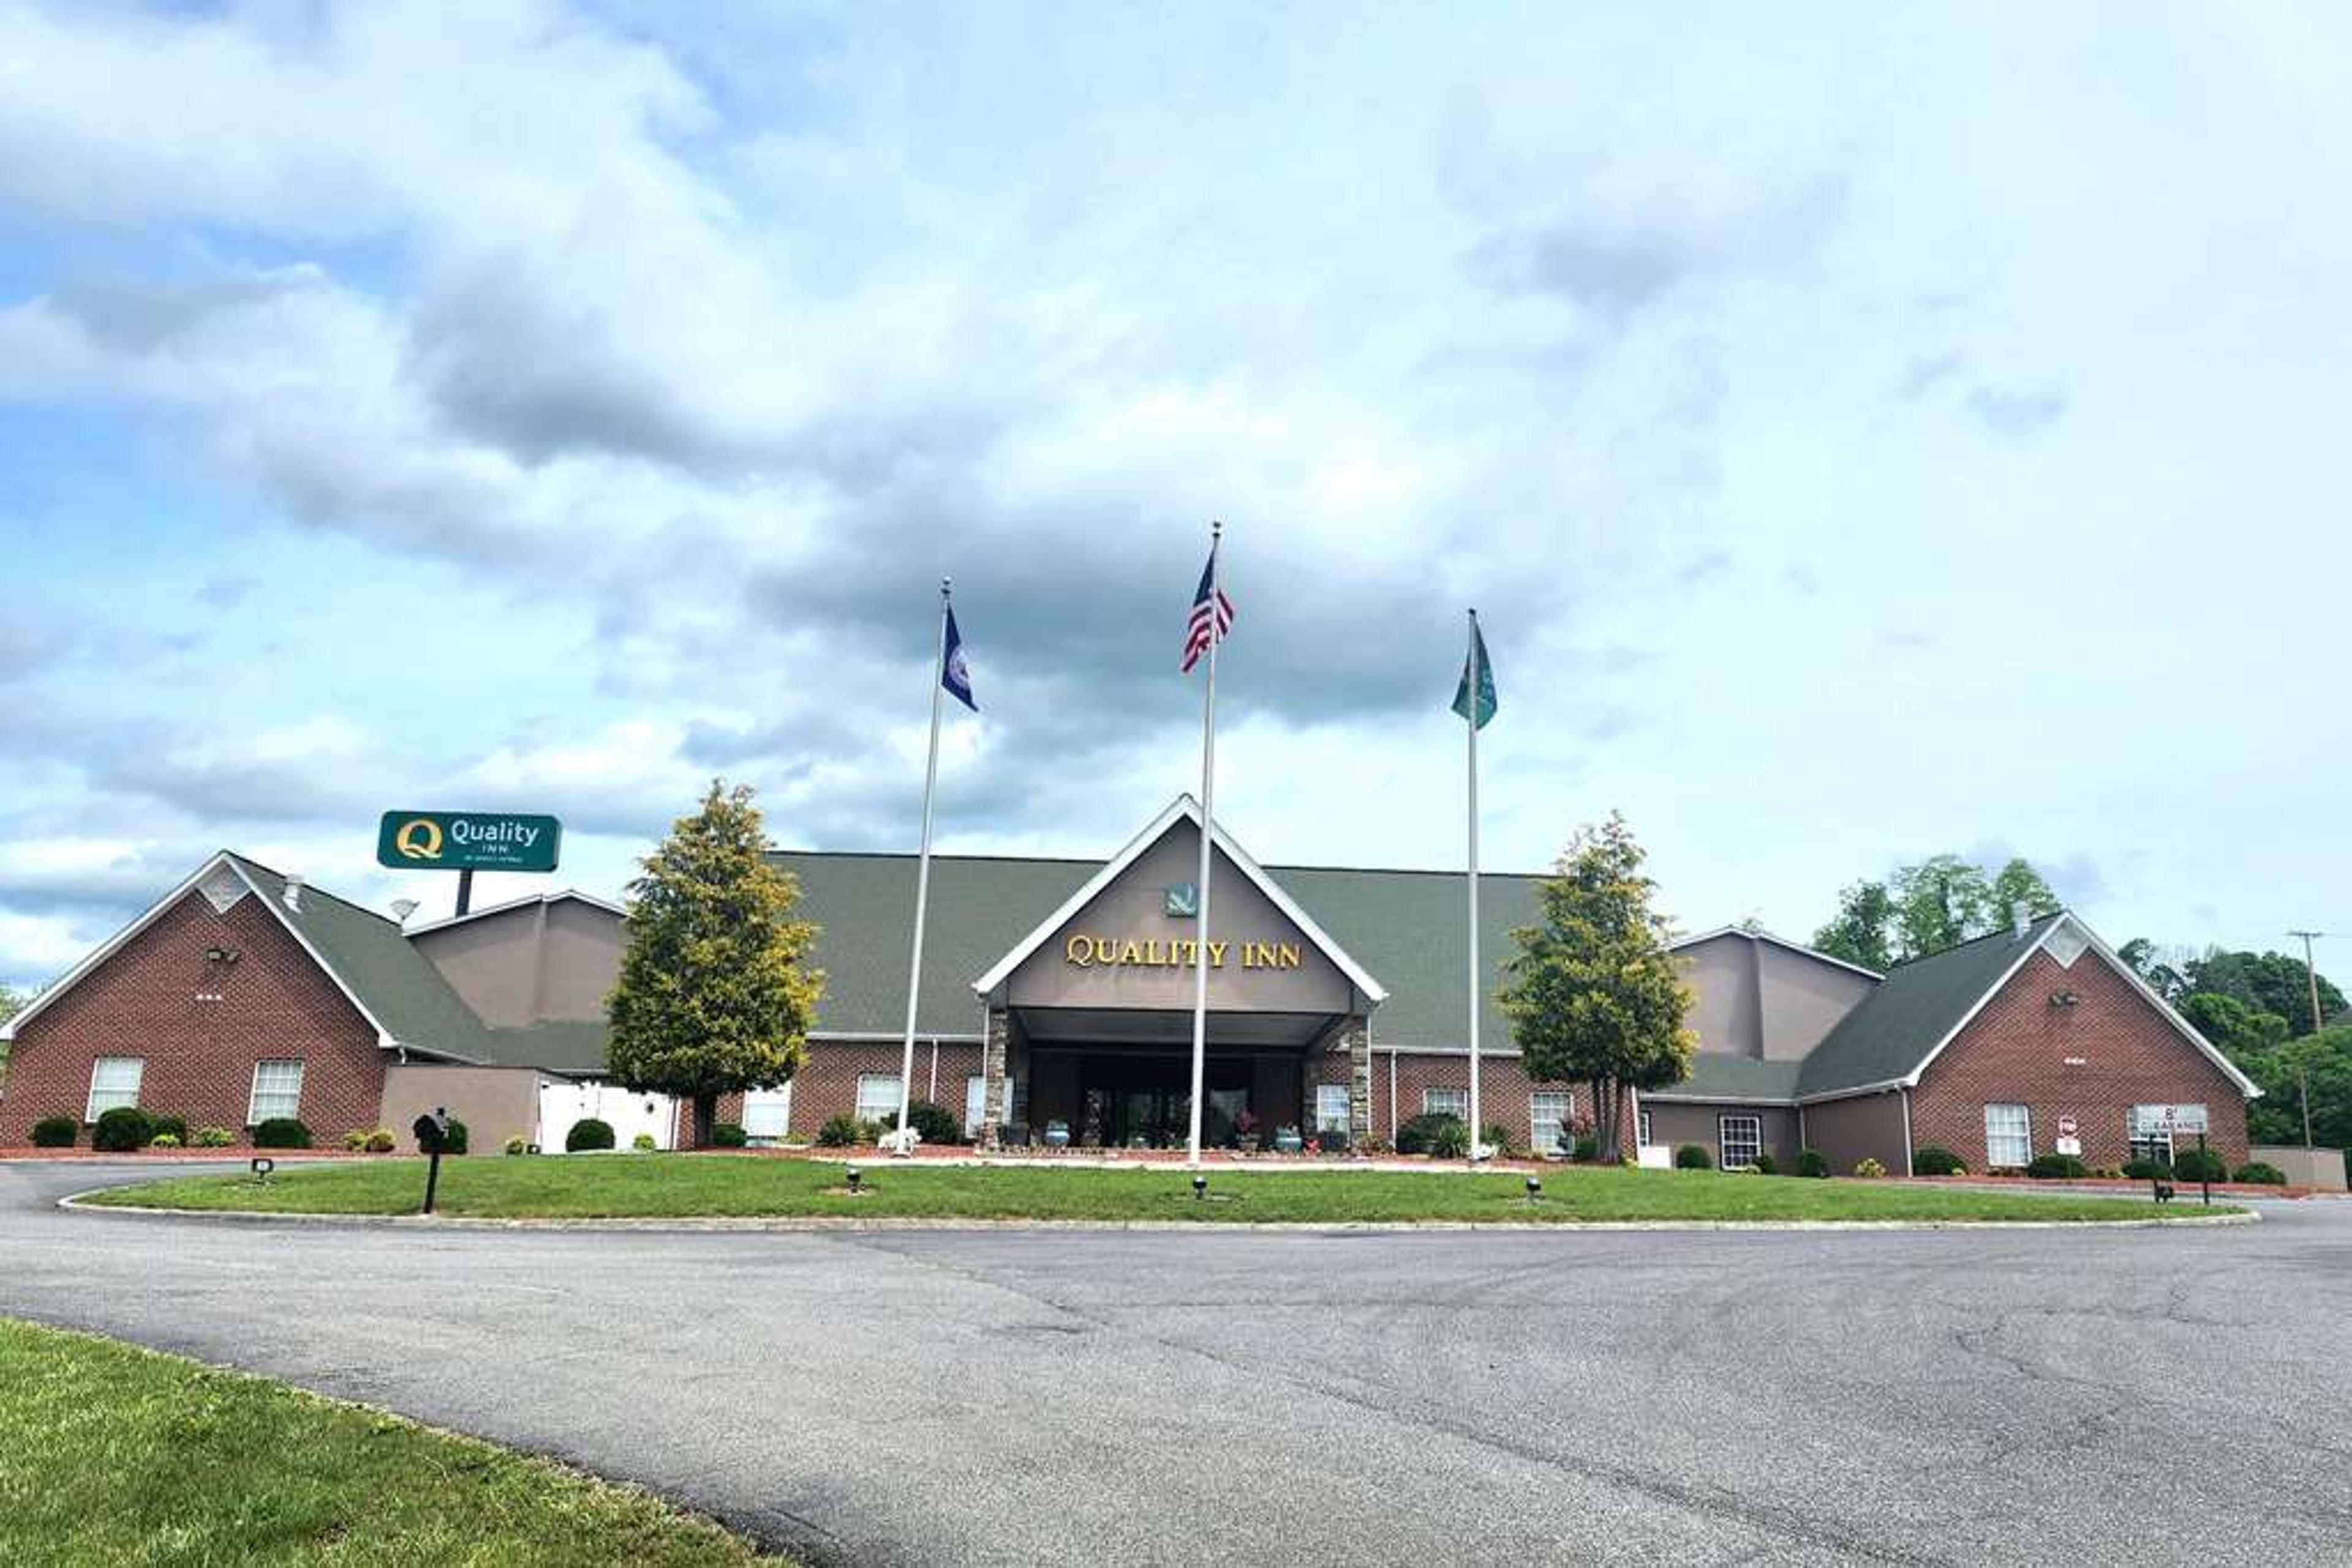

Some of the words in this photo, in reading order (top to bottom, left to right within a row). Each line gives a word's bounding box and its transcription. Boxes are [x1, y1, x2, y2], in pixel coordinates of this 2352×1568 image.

[451, 820, 539, 846] Quality
[481, 845, 509, 854] INN
[1066, 935, 1228, 966] QUALITY
[1243, 941, 1301, 967] INN
